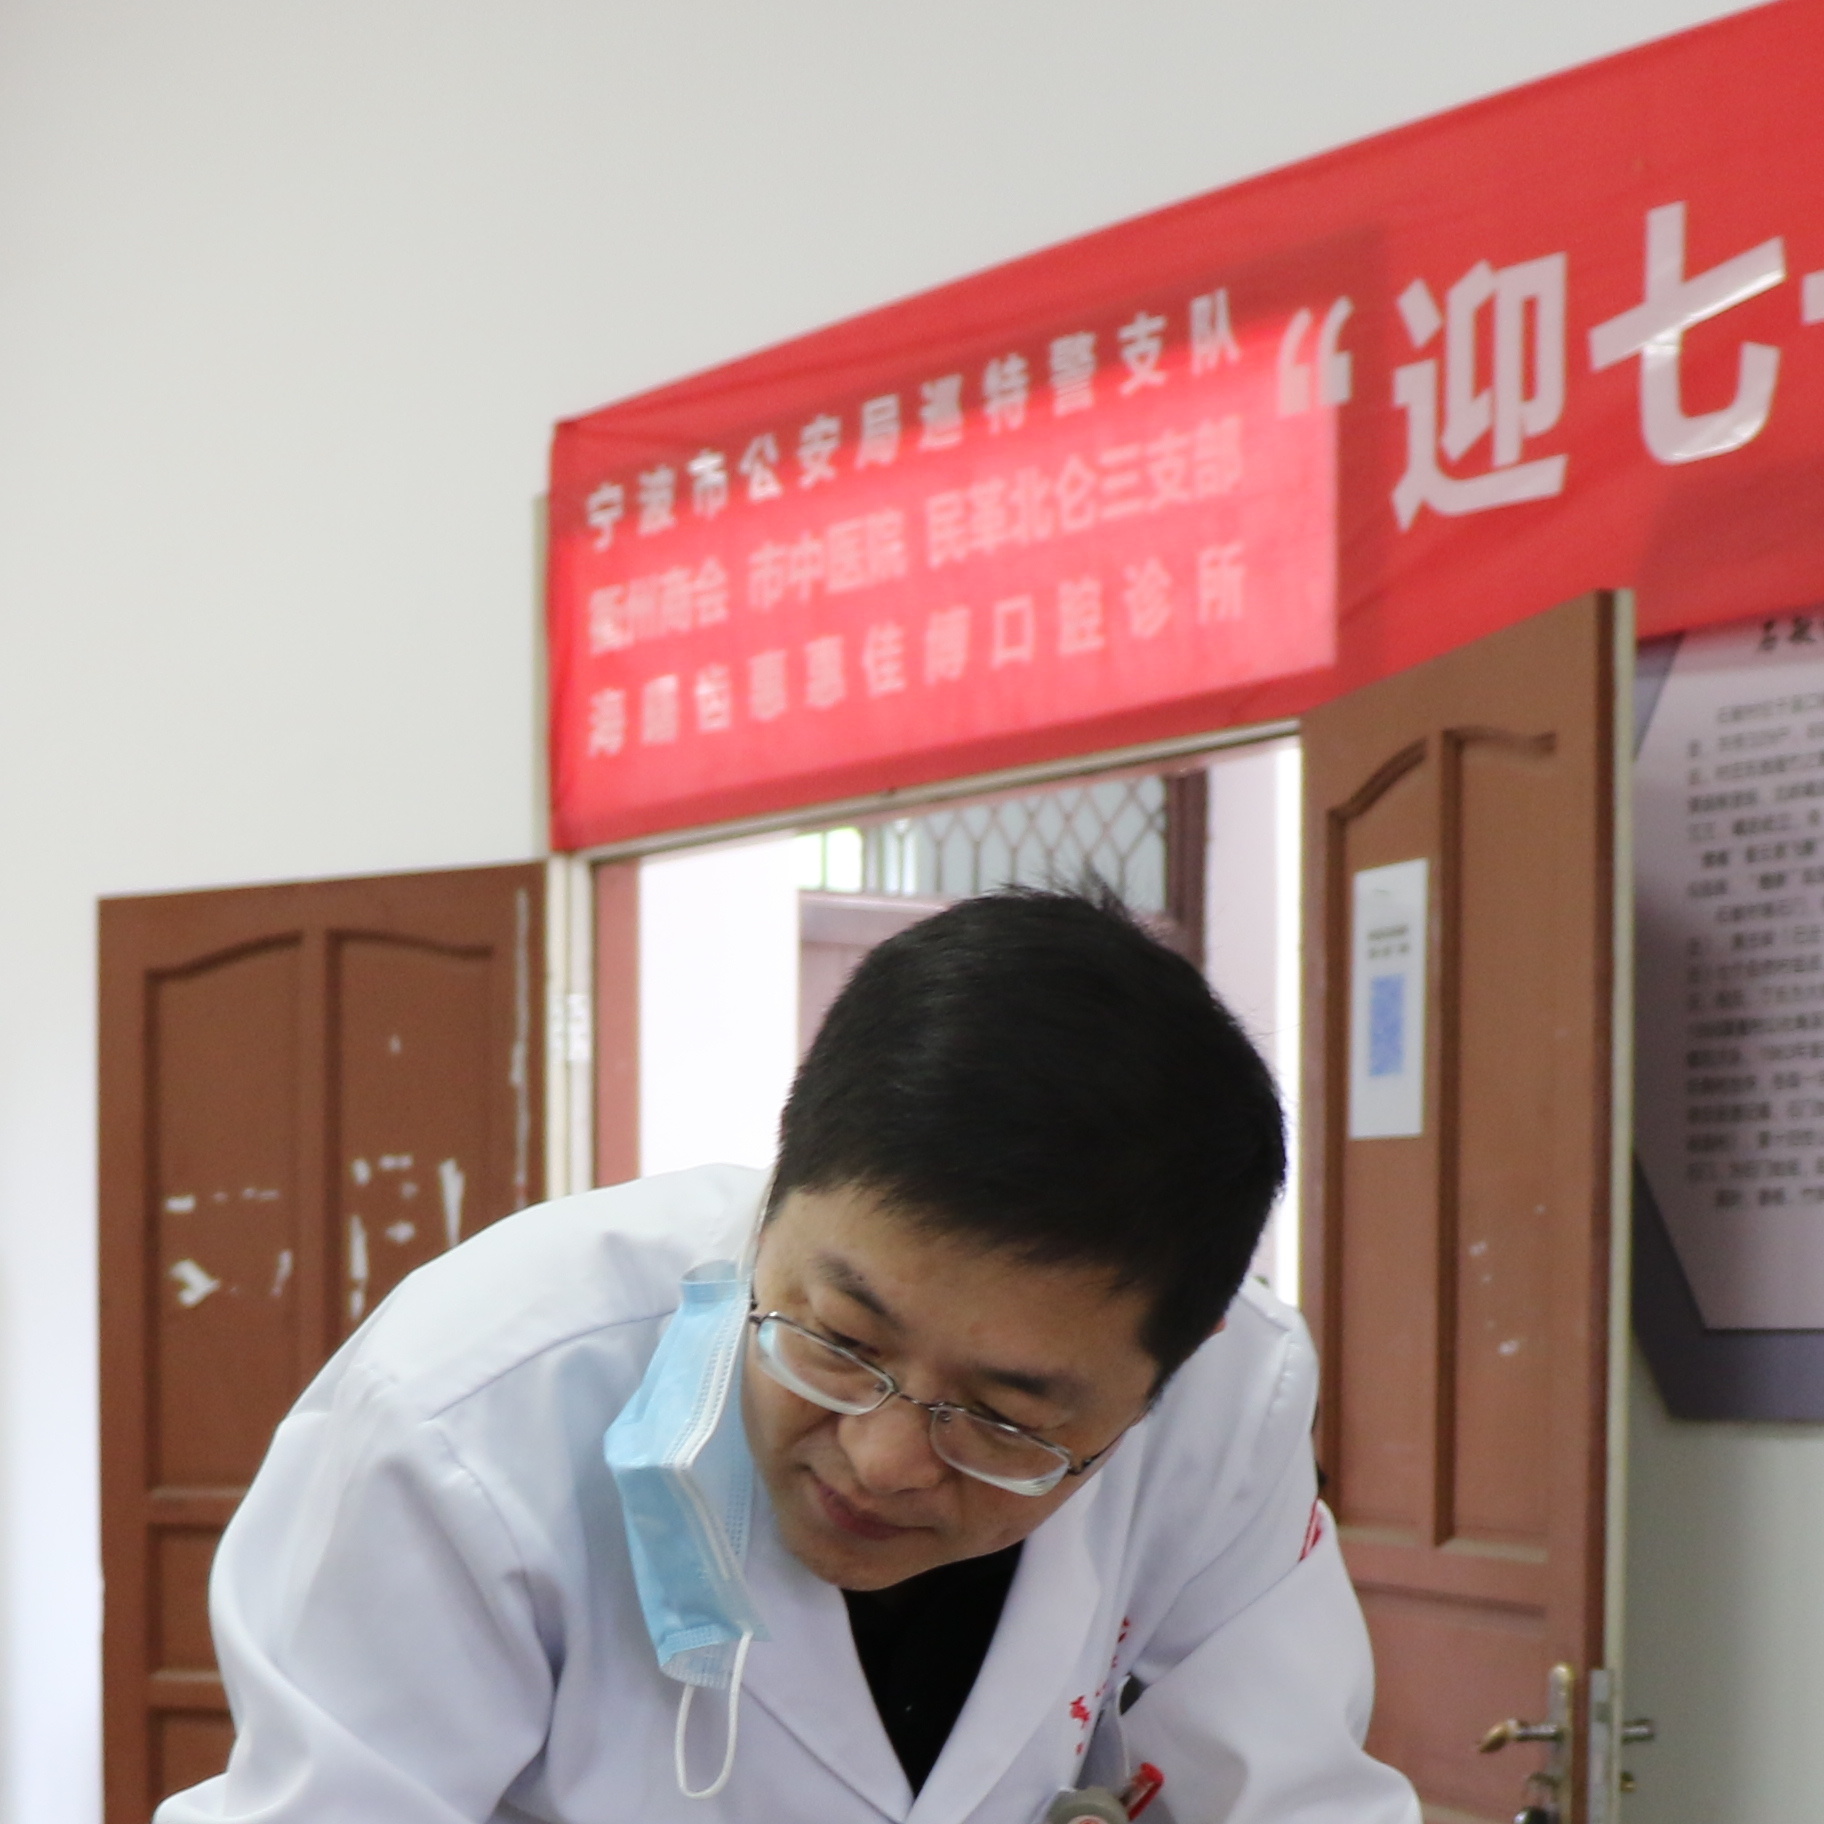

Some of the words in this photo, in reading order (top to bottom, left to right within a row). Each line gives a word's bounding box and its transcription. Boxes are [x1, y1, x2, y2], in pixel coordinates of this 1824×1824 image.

[748, 506, 907, 614] 市中医院
[927, 415, 1243, 571] 民革北仑三支部
